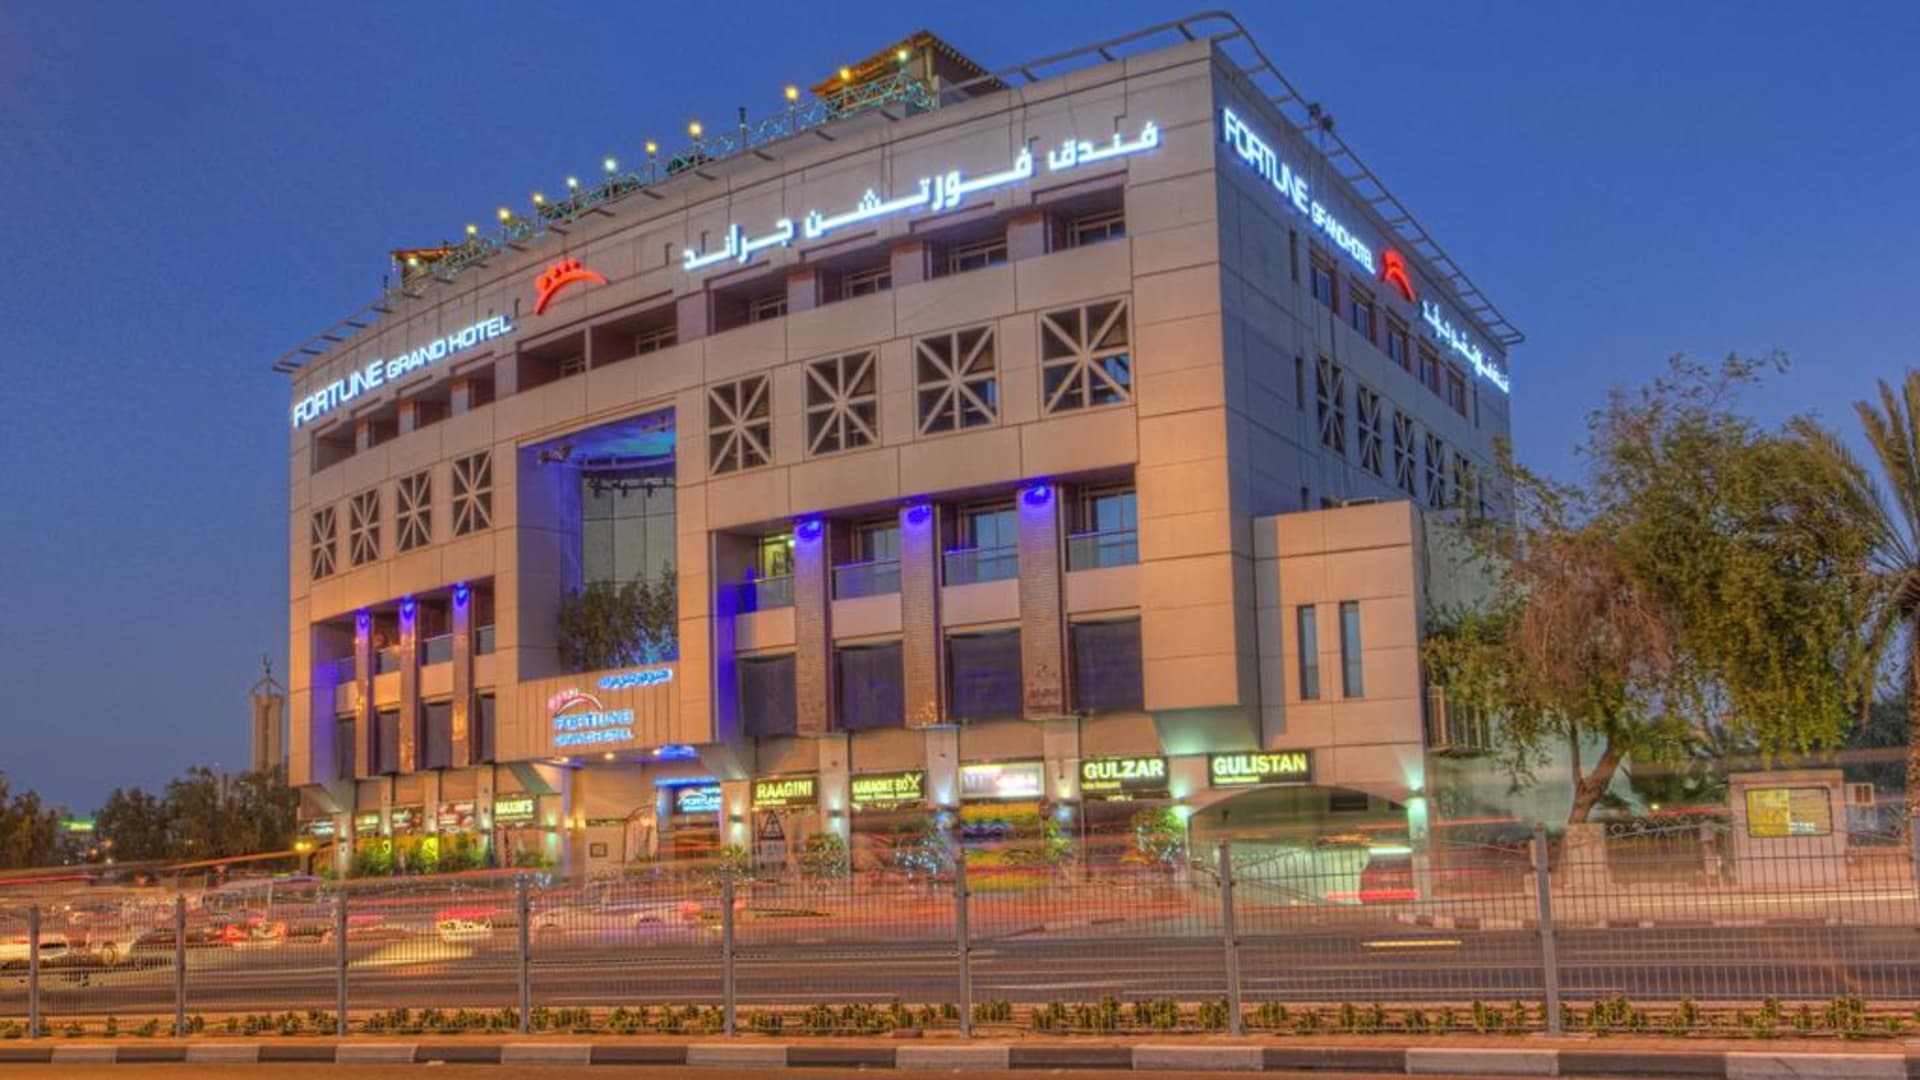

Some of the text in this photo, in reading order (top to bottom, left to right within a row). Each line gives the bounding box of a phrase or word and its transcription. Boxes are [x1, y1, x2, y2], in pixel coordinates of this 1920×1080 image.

[1048, 119, 1160, 170] فندق
[1223, 107, 1309, 215] FORTUNE
[682, 219, 798, 271] جراند
[293, 314, 512, 428] FORTUNE GRAND HOTEL
[895, 772, 922, 791] BOX
[1083, 758, 1165, 780] GULZAR
[1213, 752, 1308, 776] GULISTAN
[756, 780, 812, 798] RAAGINI
